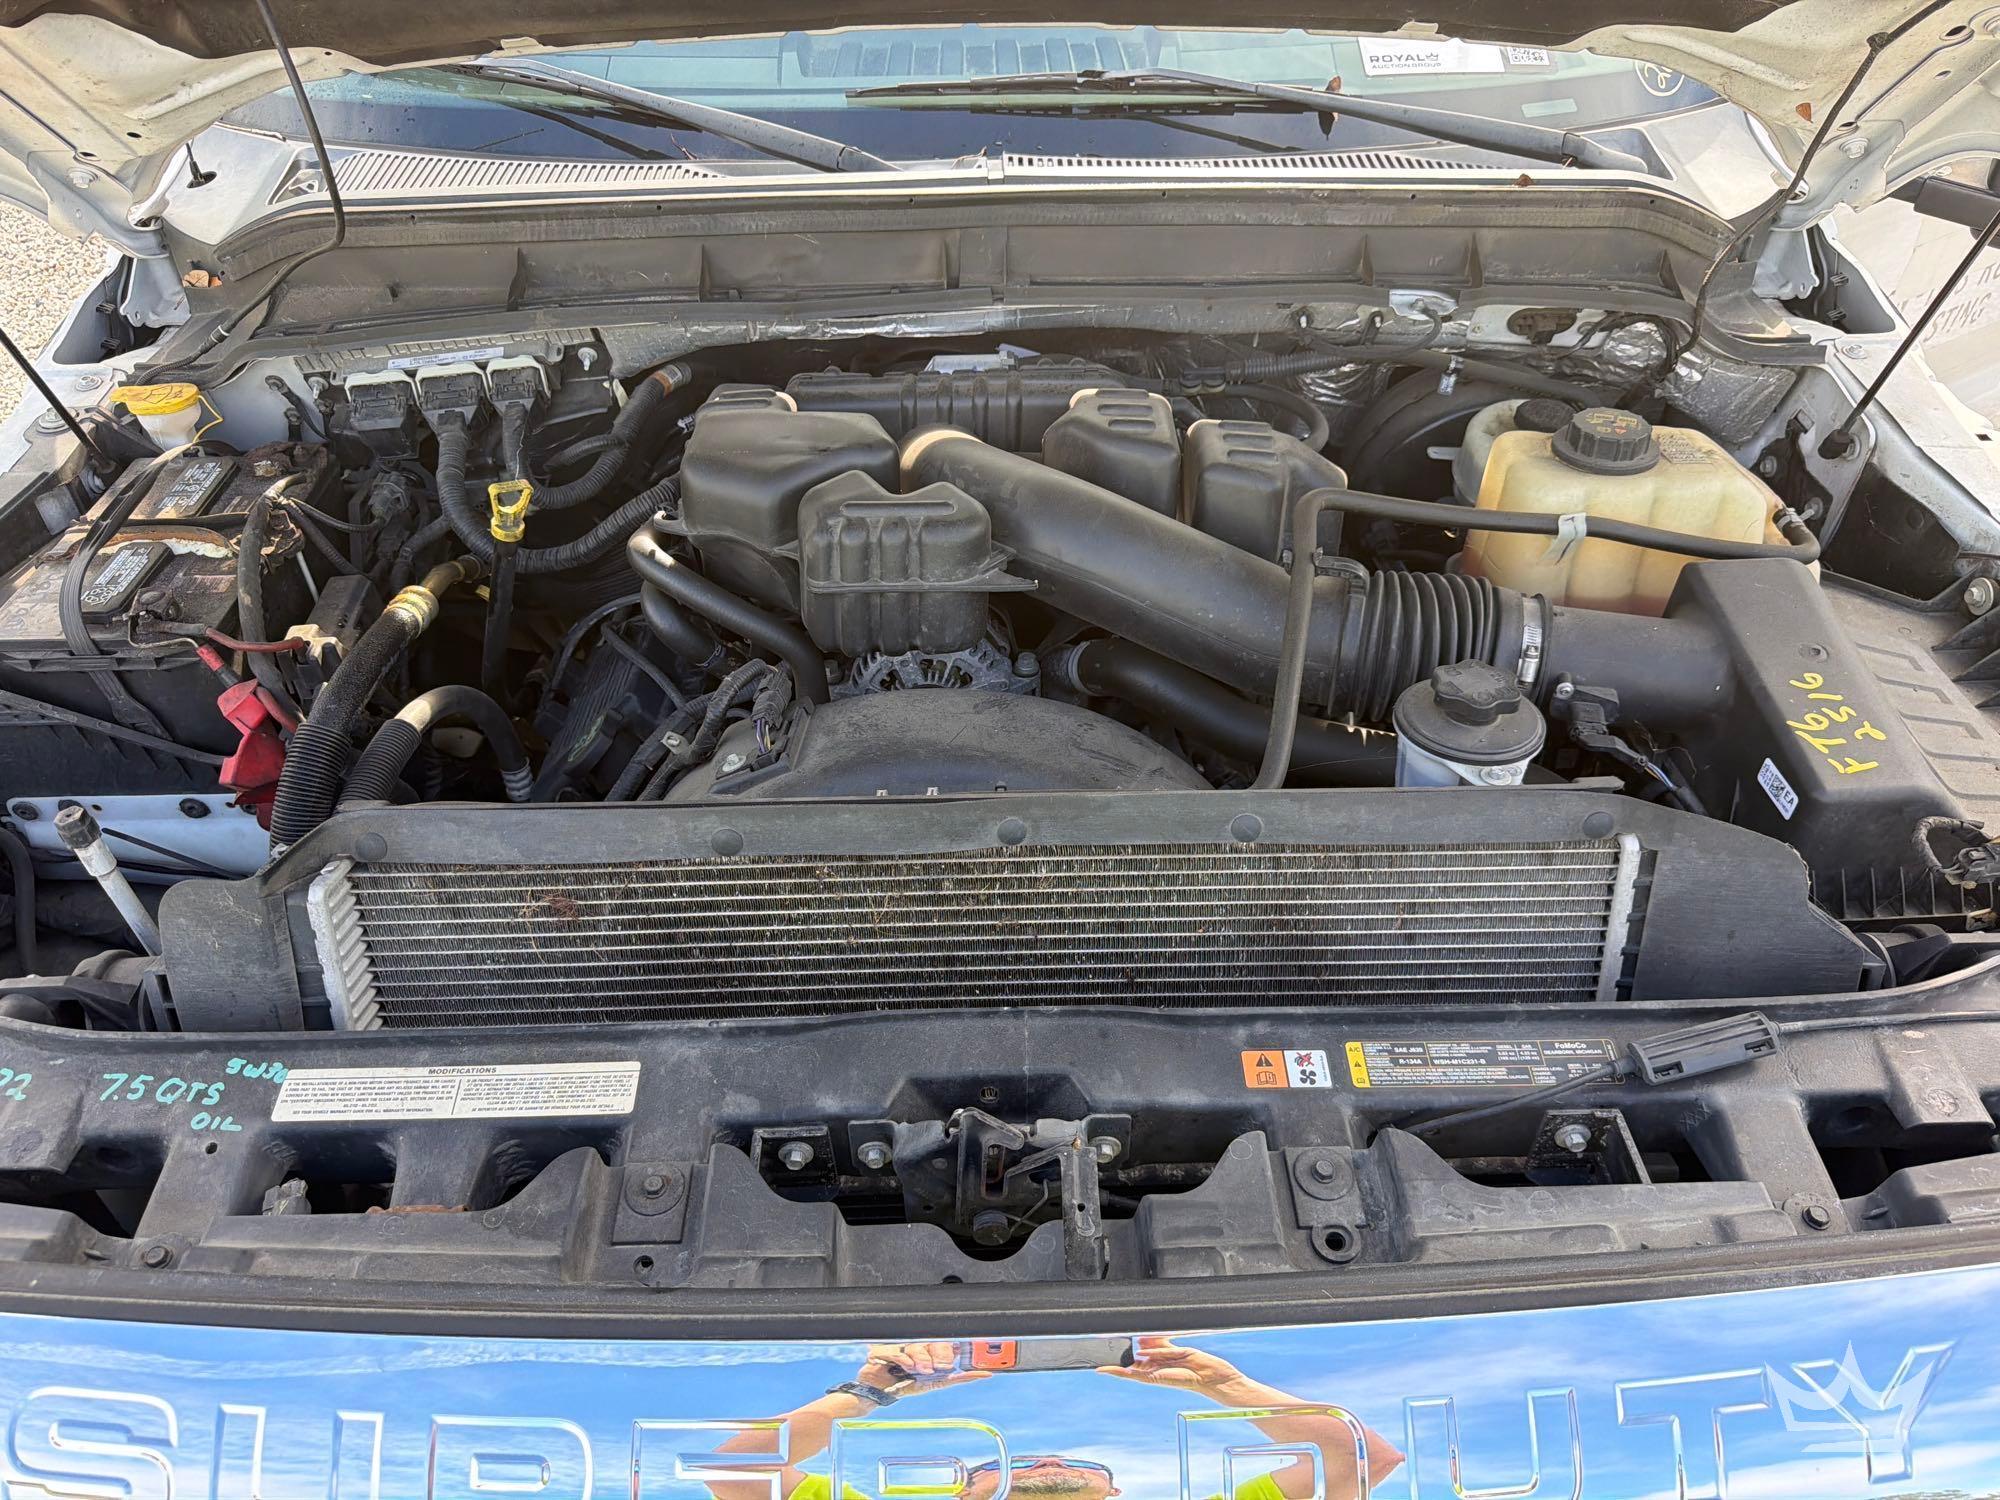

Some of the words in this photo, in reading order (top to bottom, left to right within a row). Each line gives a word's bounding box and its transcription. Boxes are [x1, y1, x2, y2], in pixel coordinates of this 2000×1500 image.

[1369, 54, 1425, 63] ROYAL
[428, 1067, 497, 1075] MODIFICATIONS
[99, 1073, 153, 1101] 7.5
[155, 1077, 225, 1106] QTS
[190, 1111, 243, 1132] OIL
[1178, 1339, 1958, 1500] DUTY
